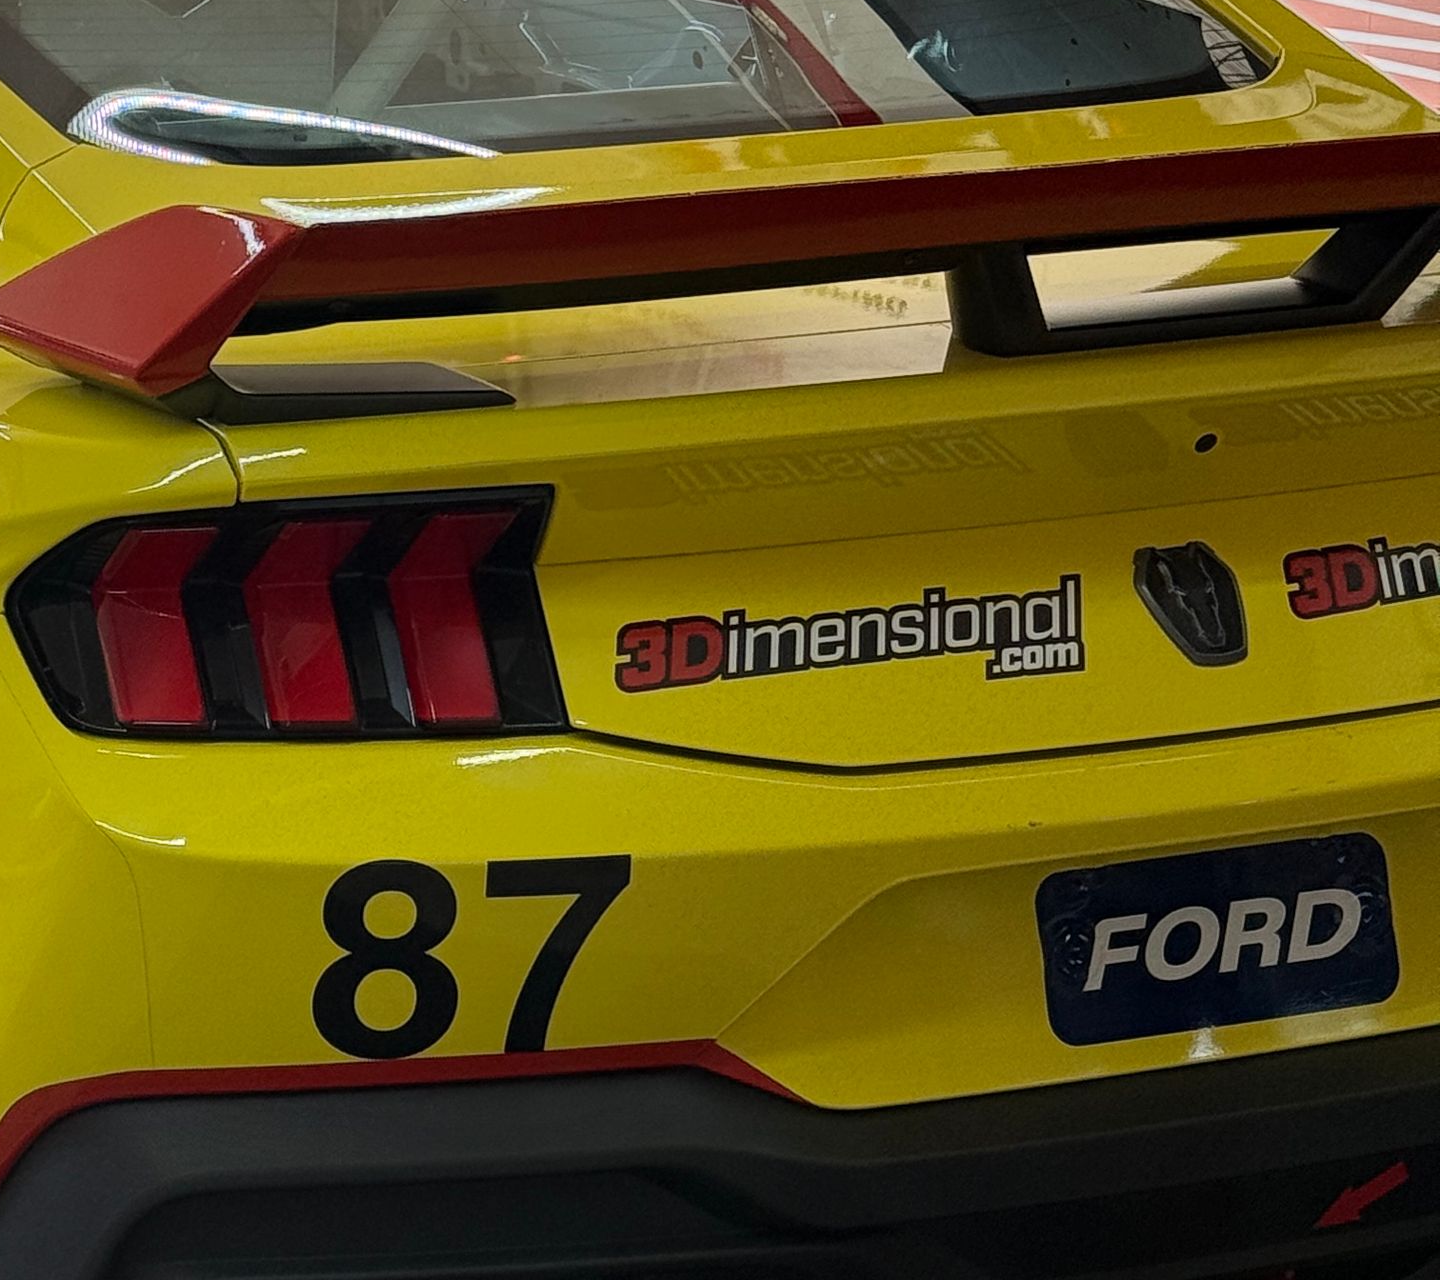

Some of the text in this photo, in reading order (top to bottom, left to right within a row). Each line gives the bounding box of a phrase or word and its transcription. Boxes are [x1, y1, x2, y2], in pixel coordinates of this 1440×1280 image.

[620, 578, 1076, 687] 3Dimensional
[992, 639, 1079, 674] .com
[311, 853, 632, 1061] 87
[1082, 887, 1362, 993] FORD
